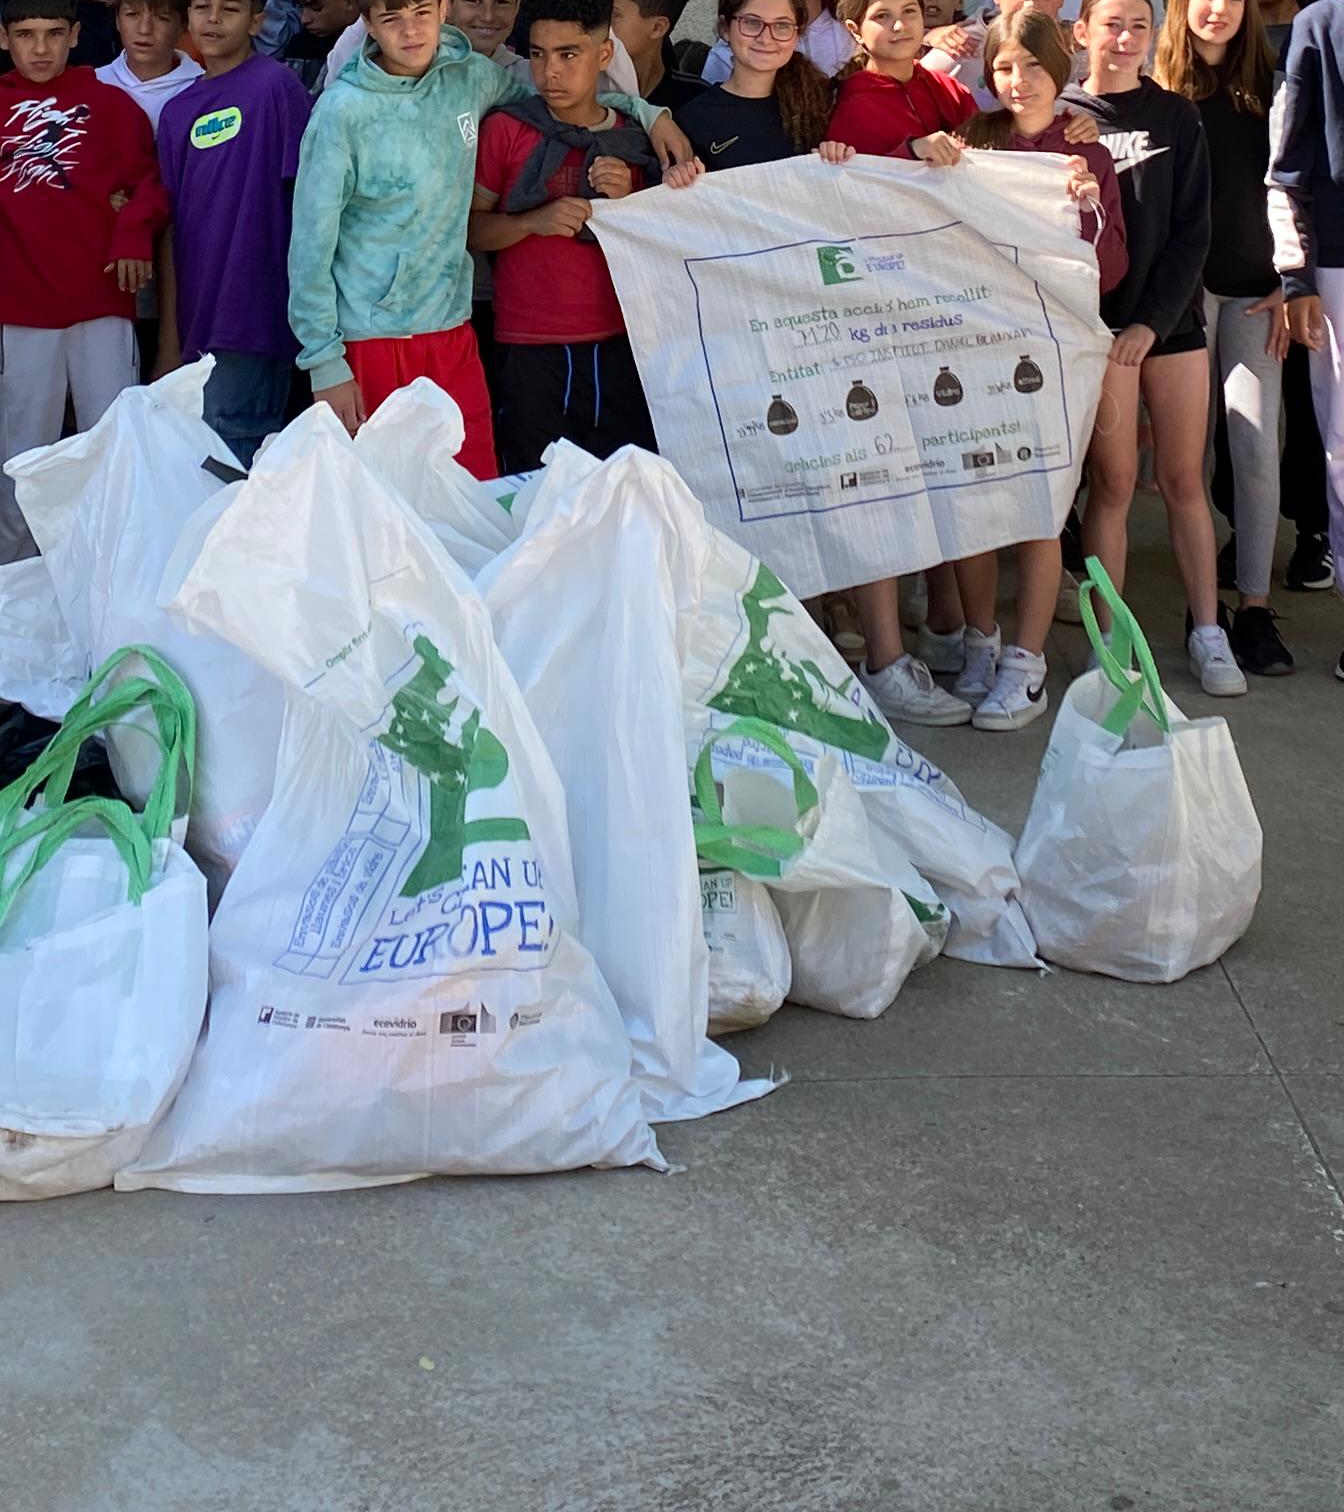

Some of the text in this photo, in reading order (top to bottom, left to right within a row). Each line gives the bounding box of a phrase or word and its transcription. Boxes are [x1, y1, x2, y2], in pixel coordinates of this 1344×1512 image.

[1098, 131, 1150, 159] NIKE
[749, 319, 769, 333] En
[773, 306, 839, 330] aquesta
[897, 296, 930, 312] hem
[848, 326, 871, 343] kg
[902, 314, 964, 332] residus
[360, 899, 554, 973] EUROPE!
